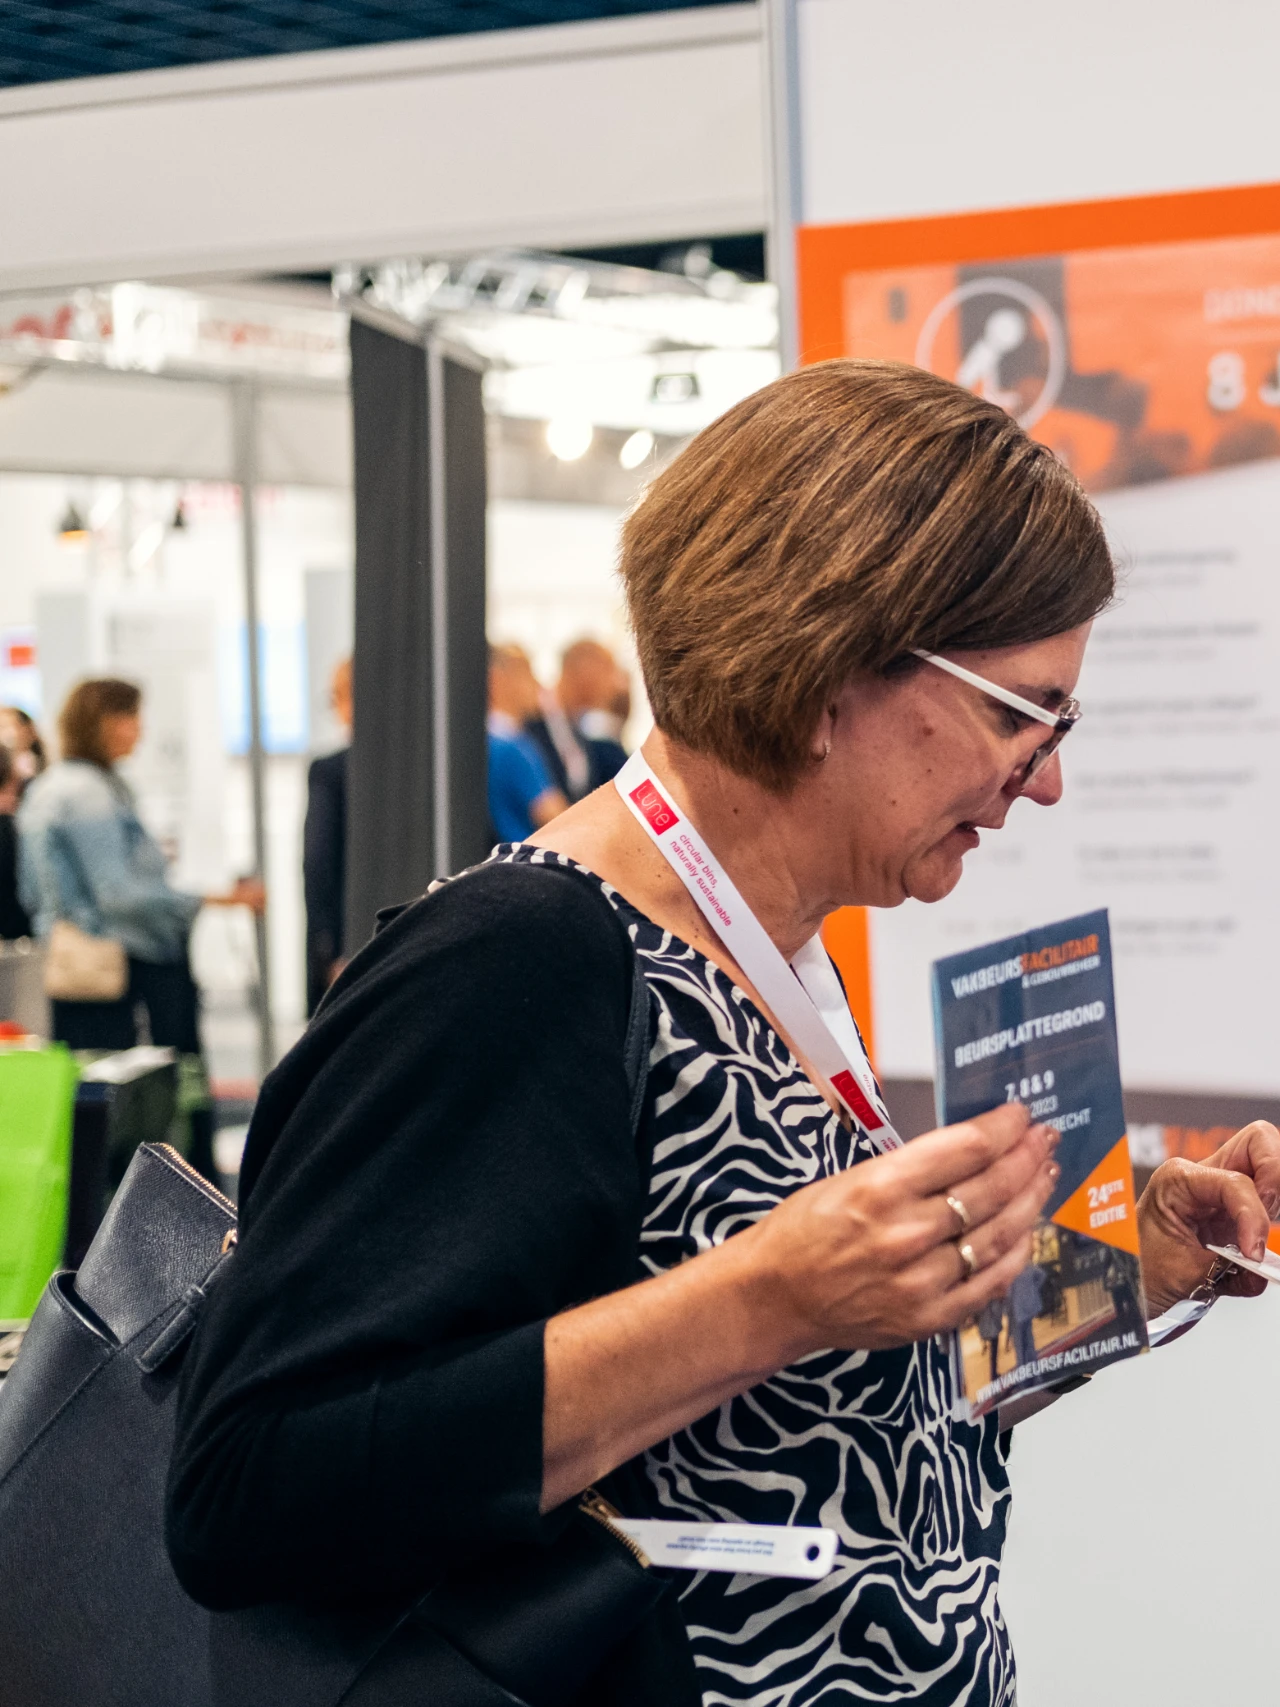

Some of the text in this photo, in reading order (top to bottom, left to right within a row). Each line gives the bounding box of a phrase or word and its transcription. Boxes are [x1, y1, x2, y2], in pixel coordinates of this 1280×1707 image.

[1207, 352, 1246, 411] 8
[670, 840, 732, 927] naturally sustainable
[680, 834, 718, 889] circular bins,
[954, 1000, 1106, 1068] BEURSPLATTEGROND
[1030, 1095, 1059, 1118] 2023
[1043, 1069, 1055, 1091] 9
[1089, 1203, 1128, 1229] EDITIE
[975, 1331, 1141, 1404] WWW.VAKBEURSFACILITAIR.NL
